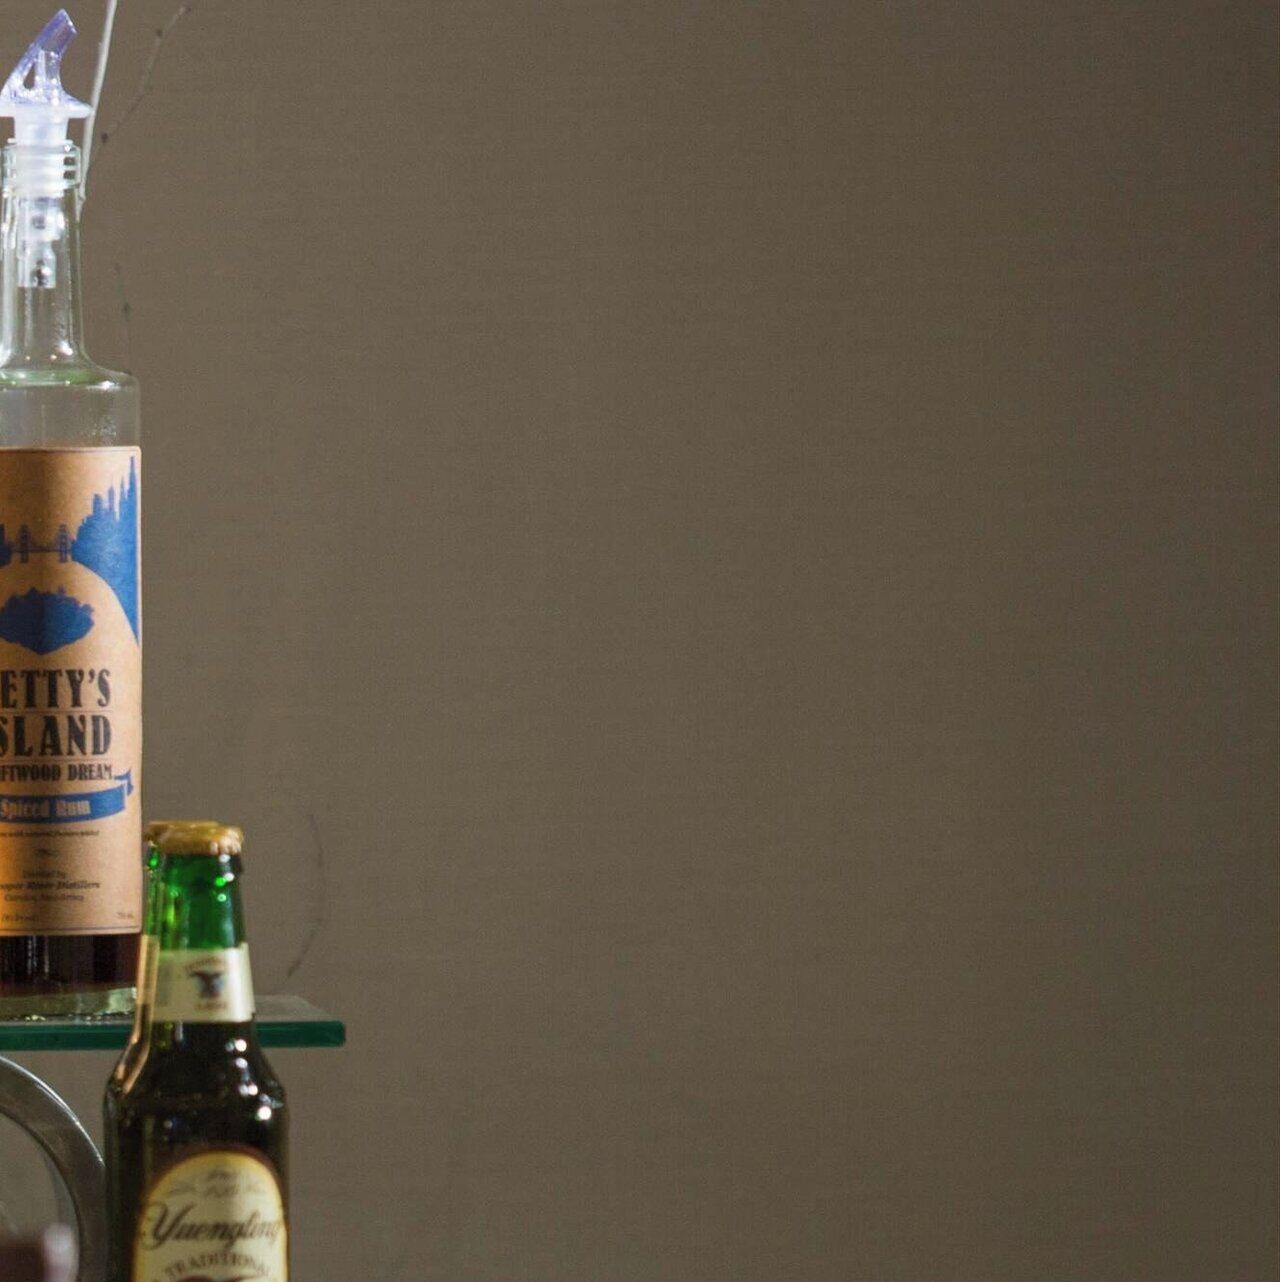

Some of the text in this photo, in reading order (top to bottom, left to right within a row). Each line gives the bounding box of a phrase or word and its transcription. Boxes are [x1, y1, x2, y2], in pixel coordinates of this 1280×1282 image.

[67, 764, 113, 781] DREAM
[0, 799, 91, 819] Spiced Rum
[142, 1201, 278, 1251] Yuengling
[165, 1253, 272, 1279] TRADITIONAL
